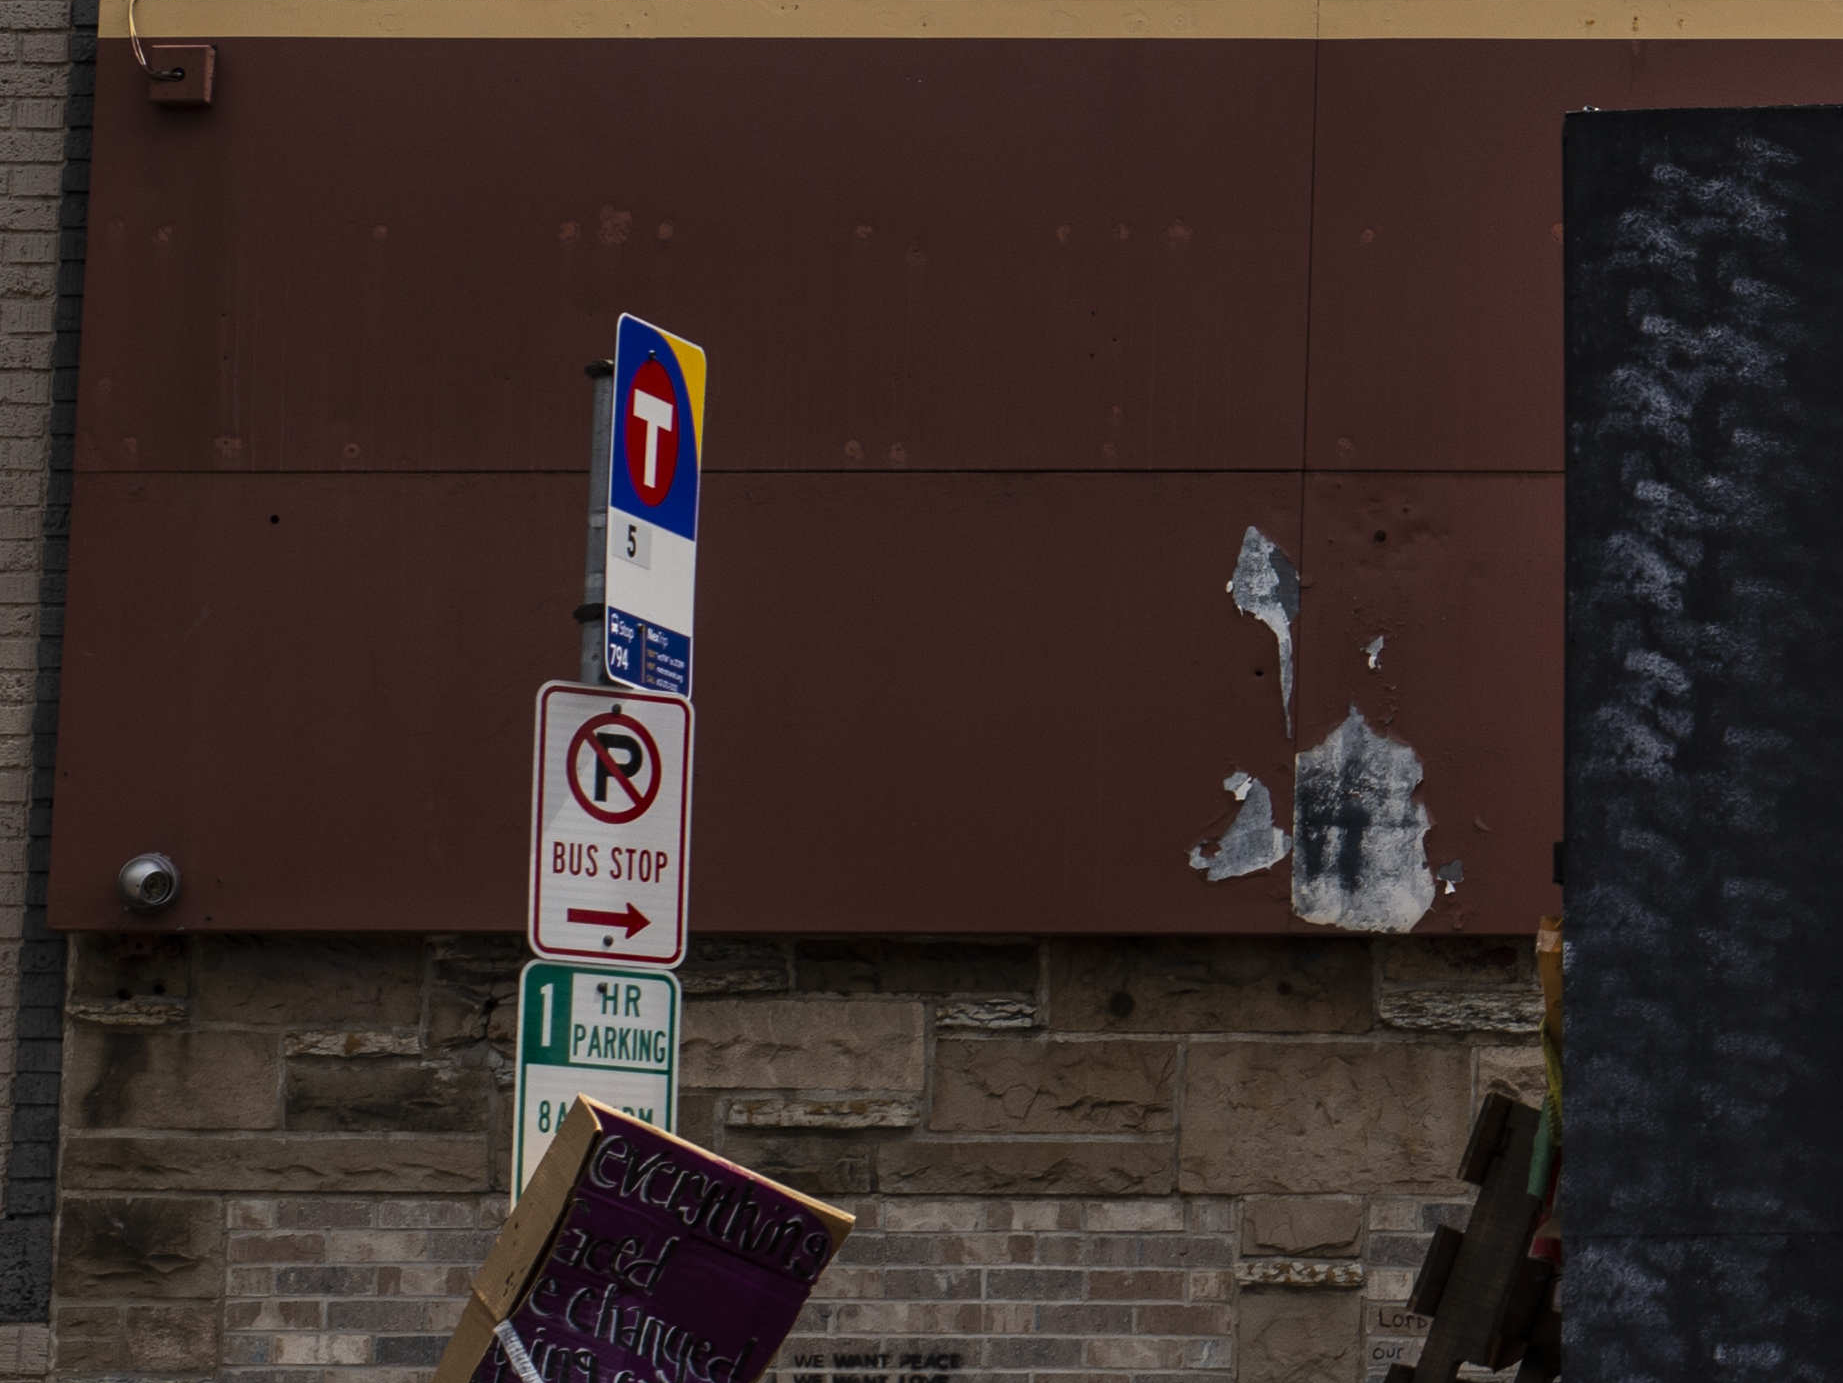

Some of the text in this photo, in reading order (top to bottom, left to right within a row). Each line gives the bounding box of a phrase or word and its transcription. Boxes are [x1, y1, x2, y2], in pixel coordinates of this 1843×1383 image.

[633, 388, 673, 489] T
[626, 524, 637, 558] 5
[610, 643, 629, 671] 794
[553, 841, 668, 883] BUS STOP
[540, 983, 642, 1047] 1 HR
[573, 1024, 666, 1063] PARKING
[538, 1100, 568, 1133] 8A
[588, 1134, 830, 1282] everything
[553, 1227, 680, 1296] aced
[793, 1353, 962, 1369] WE WANT PEACE
